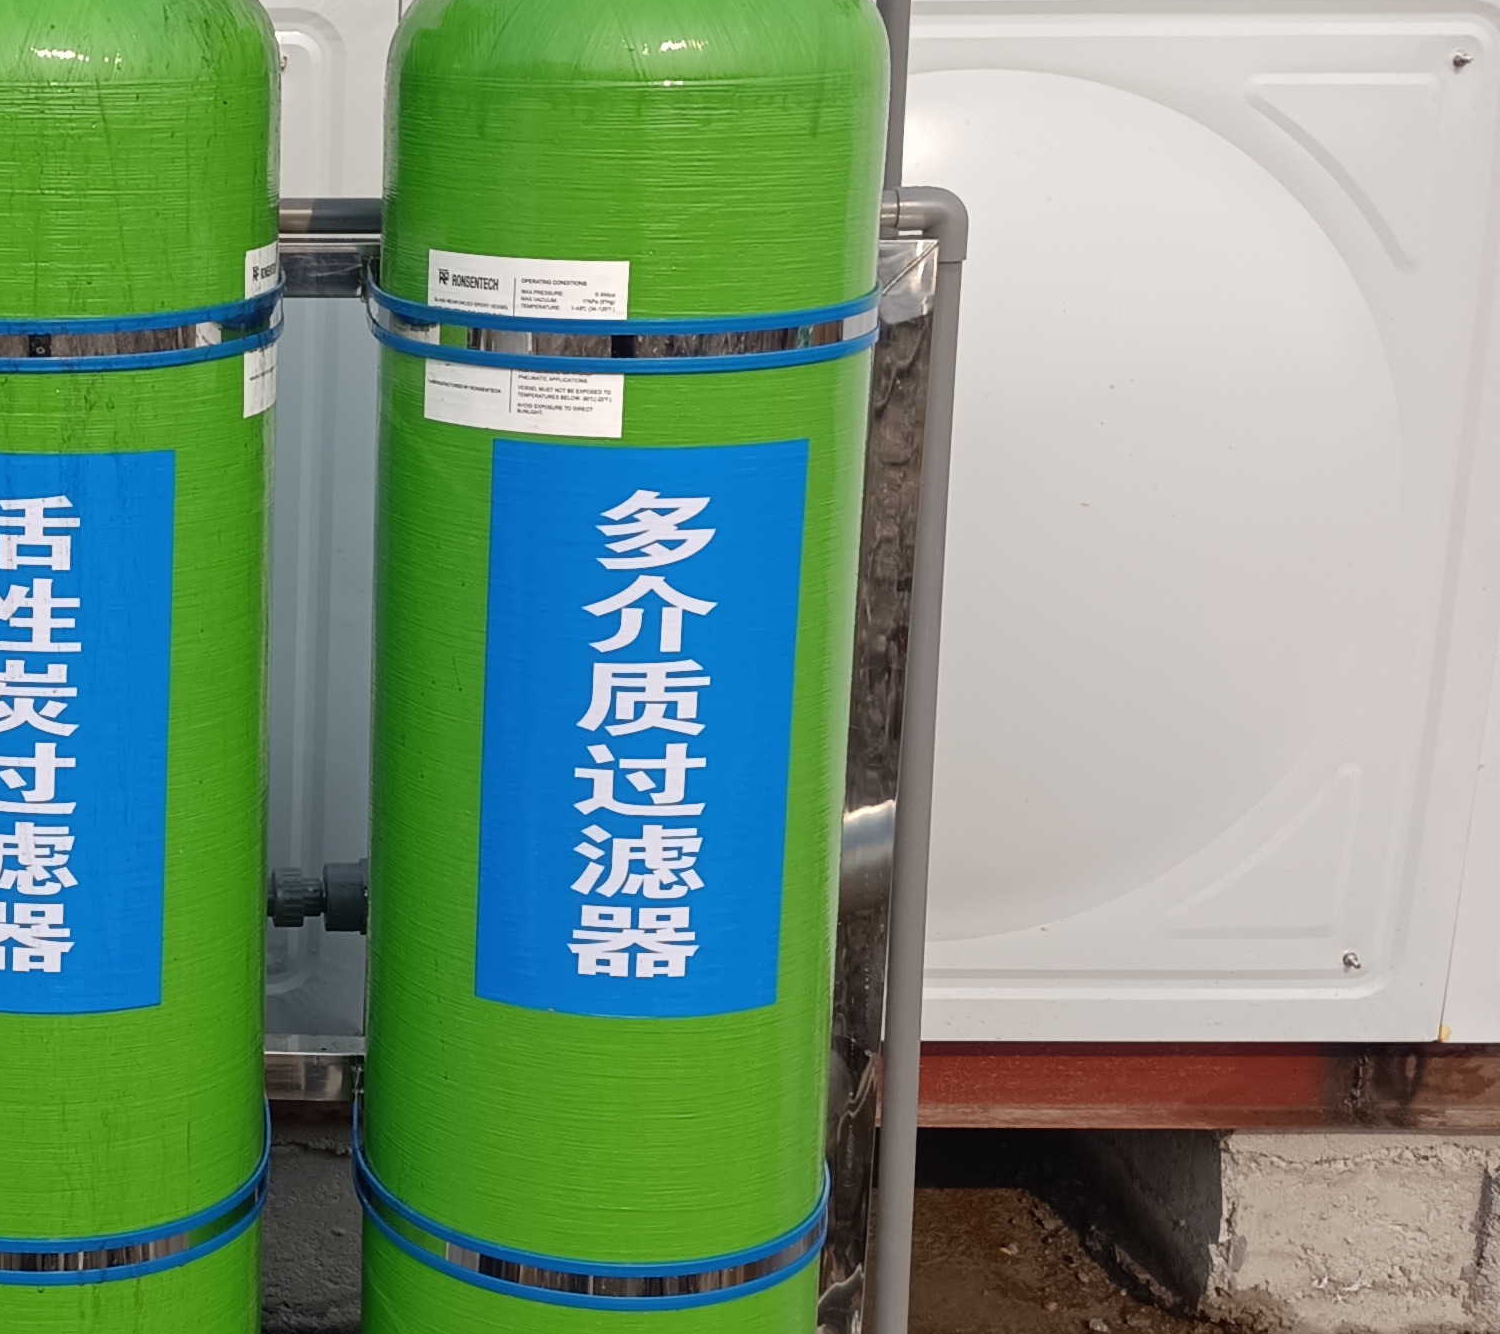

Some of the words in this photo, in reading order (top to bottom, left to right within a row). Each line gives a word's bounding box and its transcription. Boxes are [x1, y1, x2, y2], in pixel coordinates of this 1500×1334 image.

[452, 274, 499, 291] RONSENTECH
[568, 489, 717, 978] 多介质过滤器
